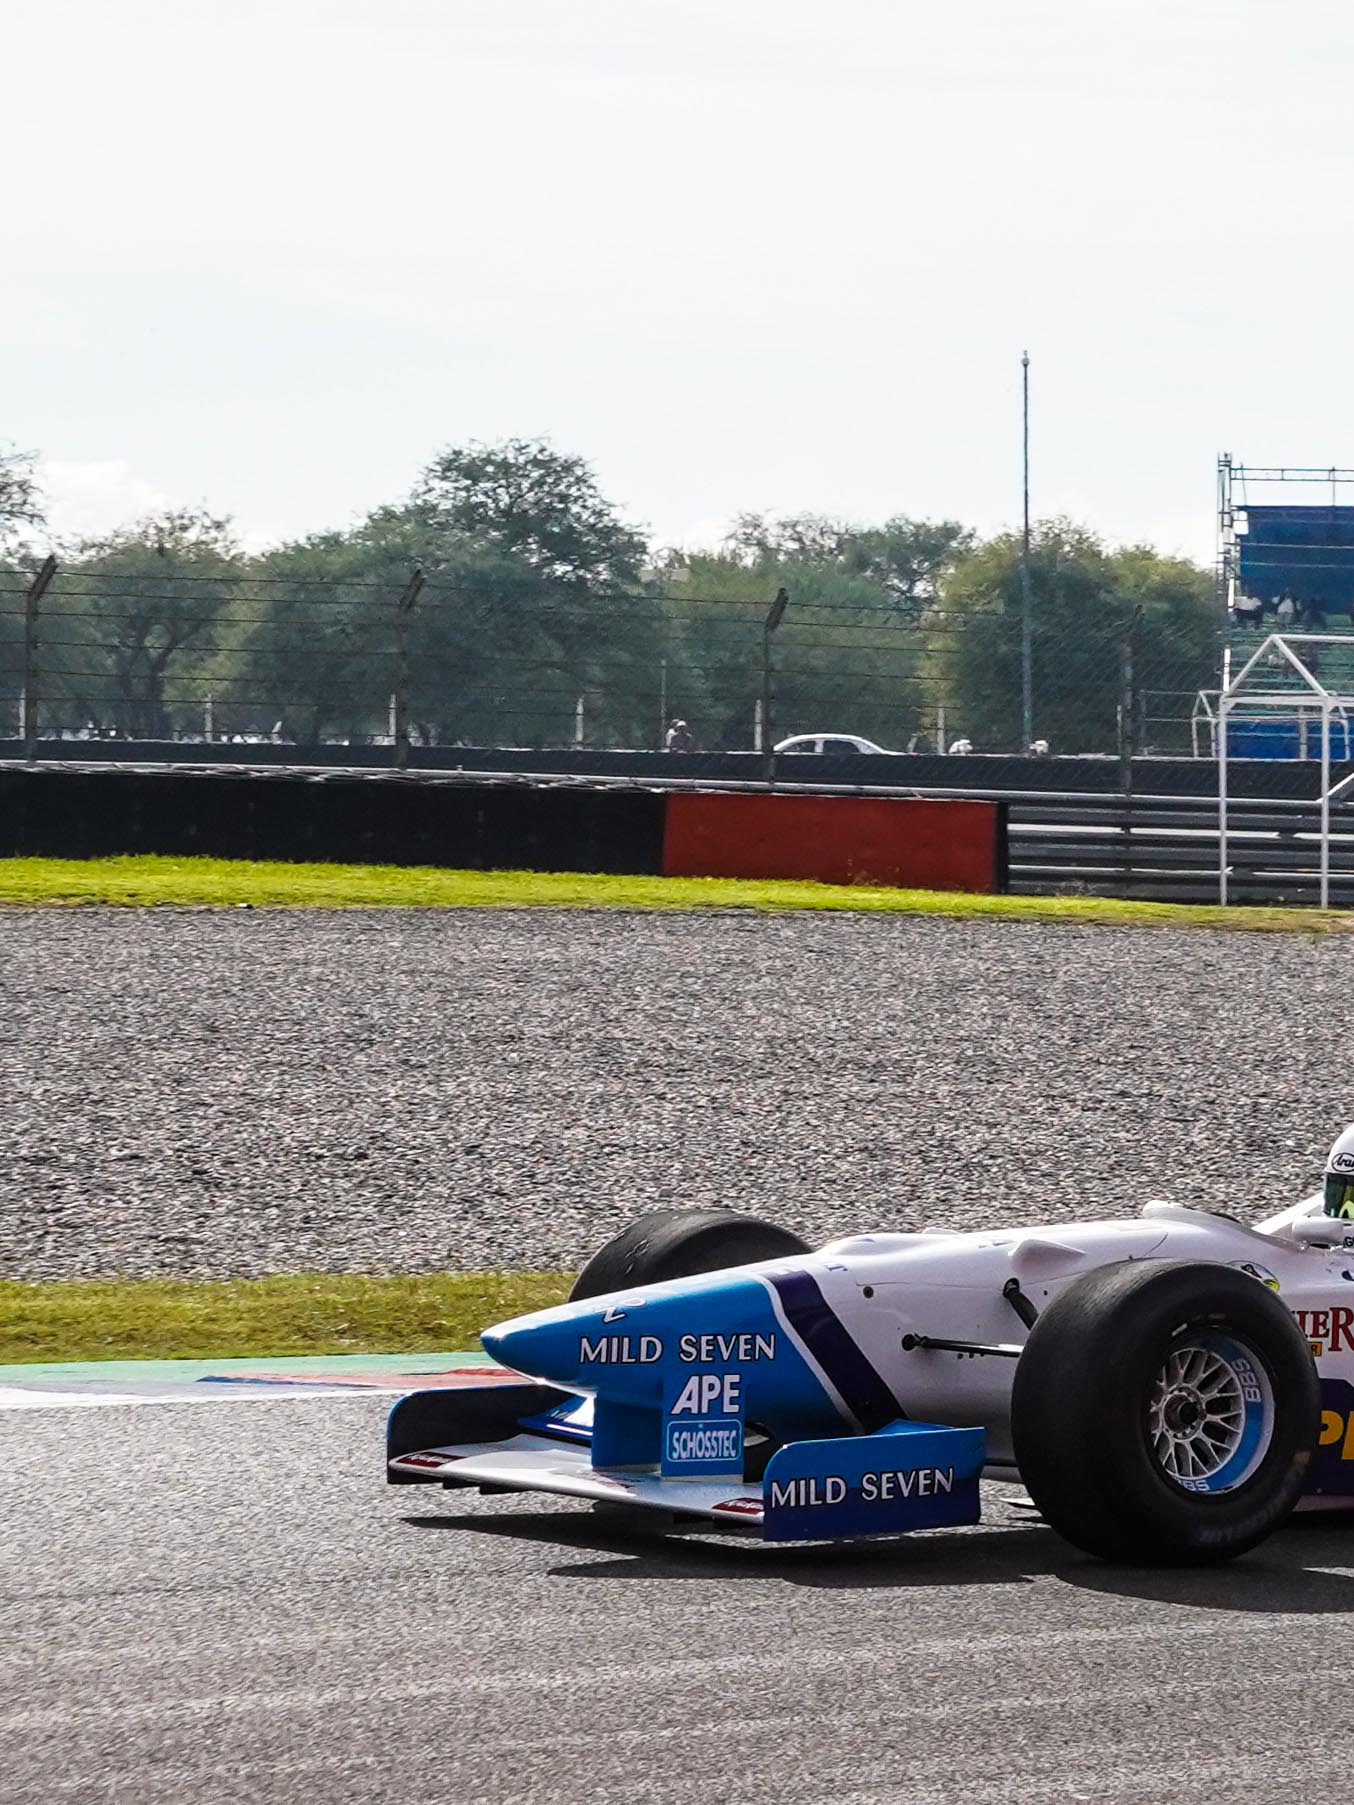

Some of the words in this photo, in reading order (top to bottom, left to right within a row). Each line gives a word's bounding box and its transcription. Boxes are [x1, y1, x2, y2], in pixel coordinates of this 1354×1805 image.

[579, 1335, 663, 1364] MILD
[679, 1333, 776, 1362] SEVEN
[670, 1373, 741, 1415] APE
[1231, 1357, 1262, 1403] BBS
[770, 1476, 847, 1509] MILD
[861, 1467, 953, 1501] SEVEN
